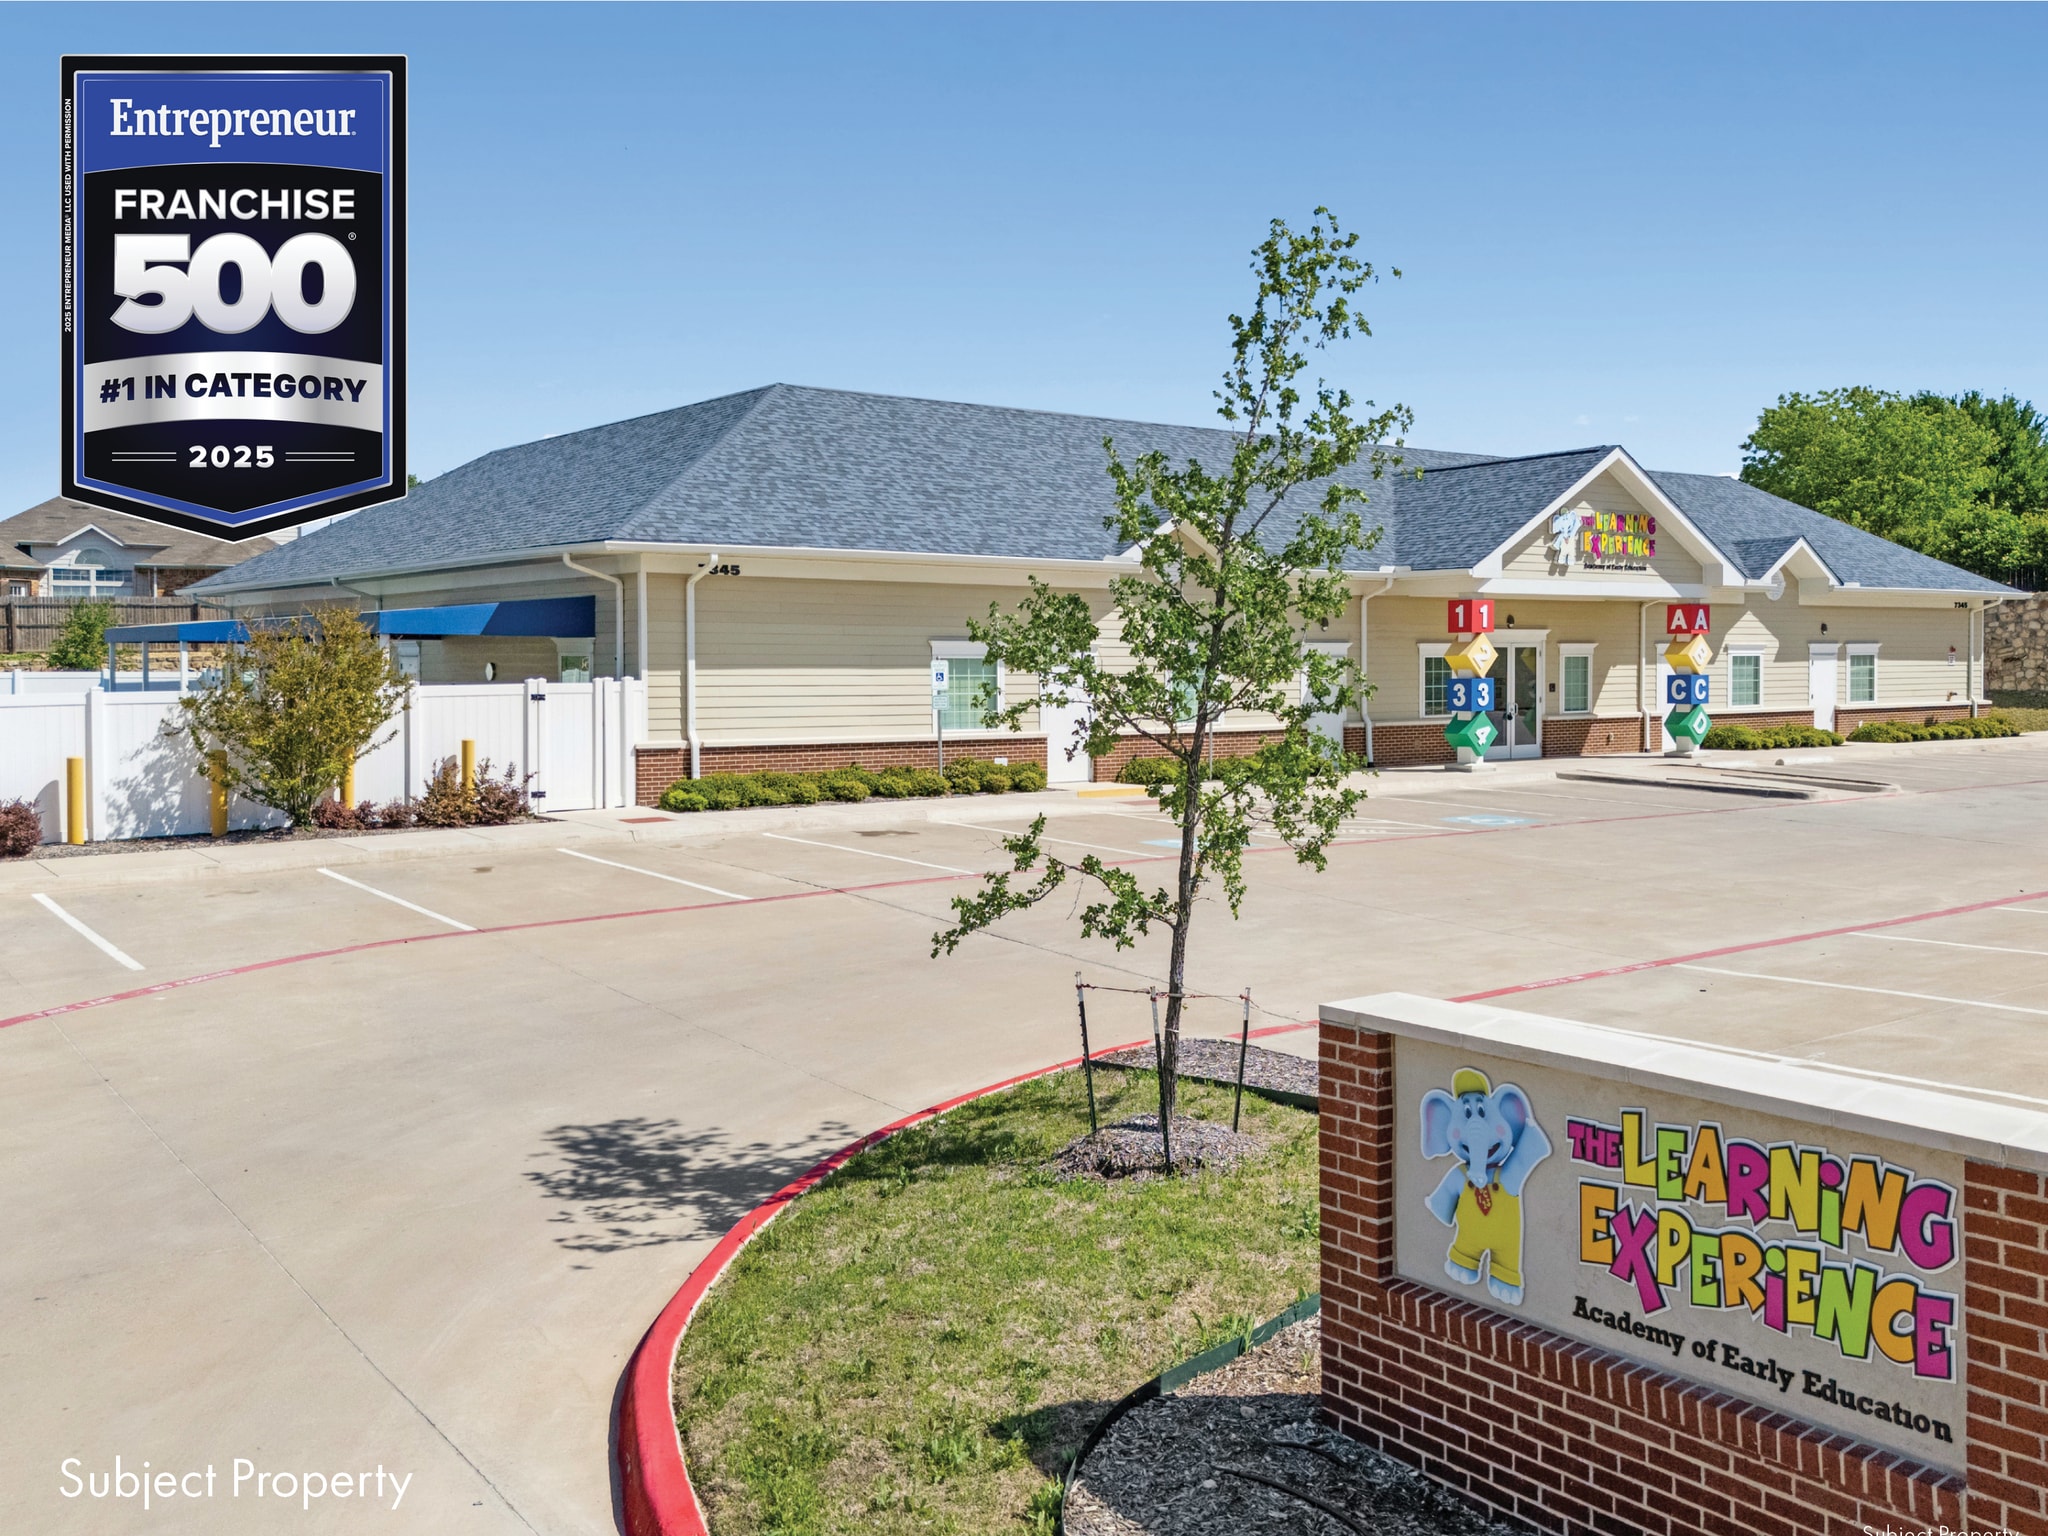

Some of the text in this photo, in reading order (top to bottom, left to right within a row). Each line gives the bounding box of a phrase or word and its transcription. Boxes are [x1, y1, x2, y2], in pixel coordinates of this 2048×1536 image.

[1455, 604, 1464, 628] 1
[1479, 604, 1488, 628] 1
[1670, 608, 1688, 630] A
[1694, 608, 1708, 630] A
[1453, 683, 1466, 707] 3
[1477, 683, 1489, 707] 3
[1671, 679, 1687, 700] C
[1694, 679, 1707, 700] C
[1692, 711, 1707, 735] D
[1475, 725, 1492, 746] 4
[1567, 1119, 1622, 1168] THE
[1573, 1297, 1953, 1444] Academy of Early Education
